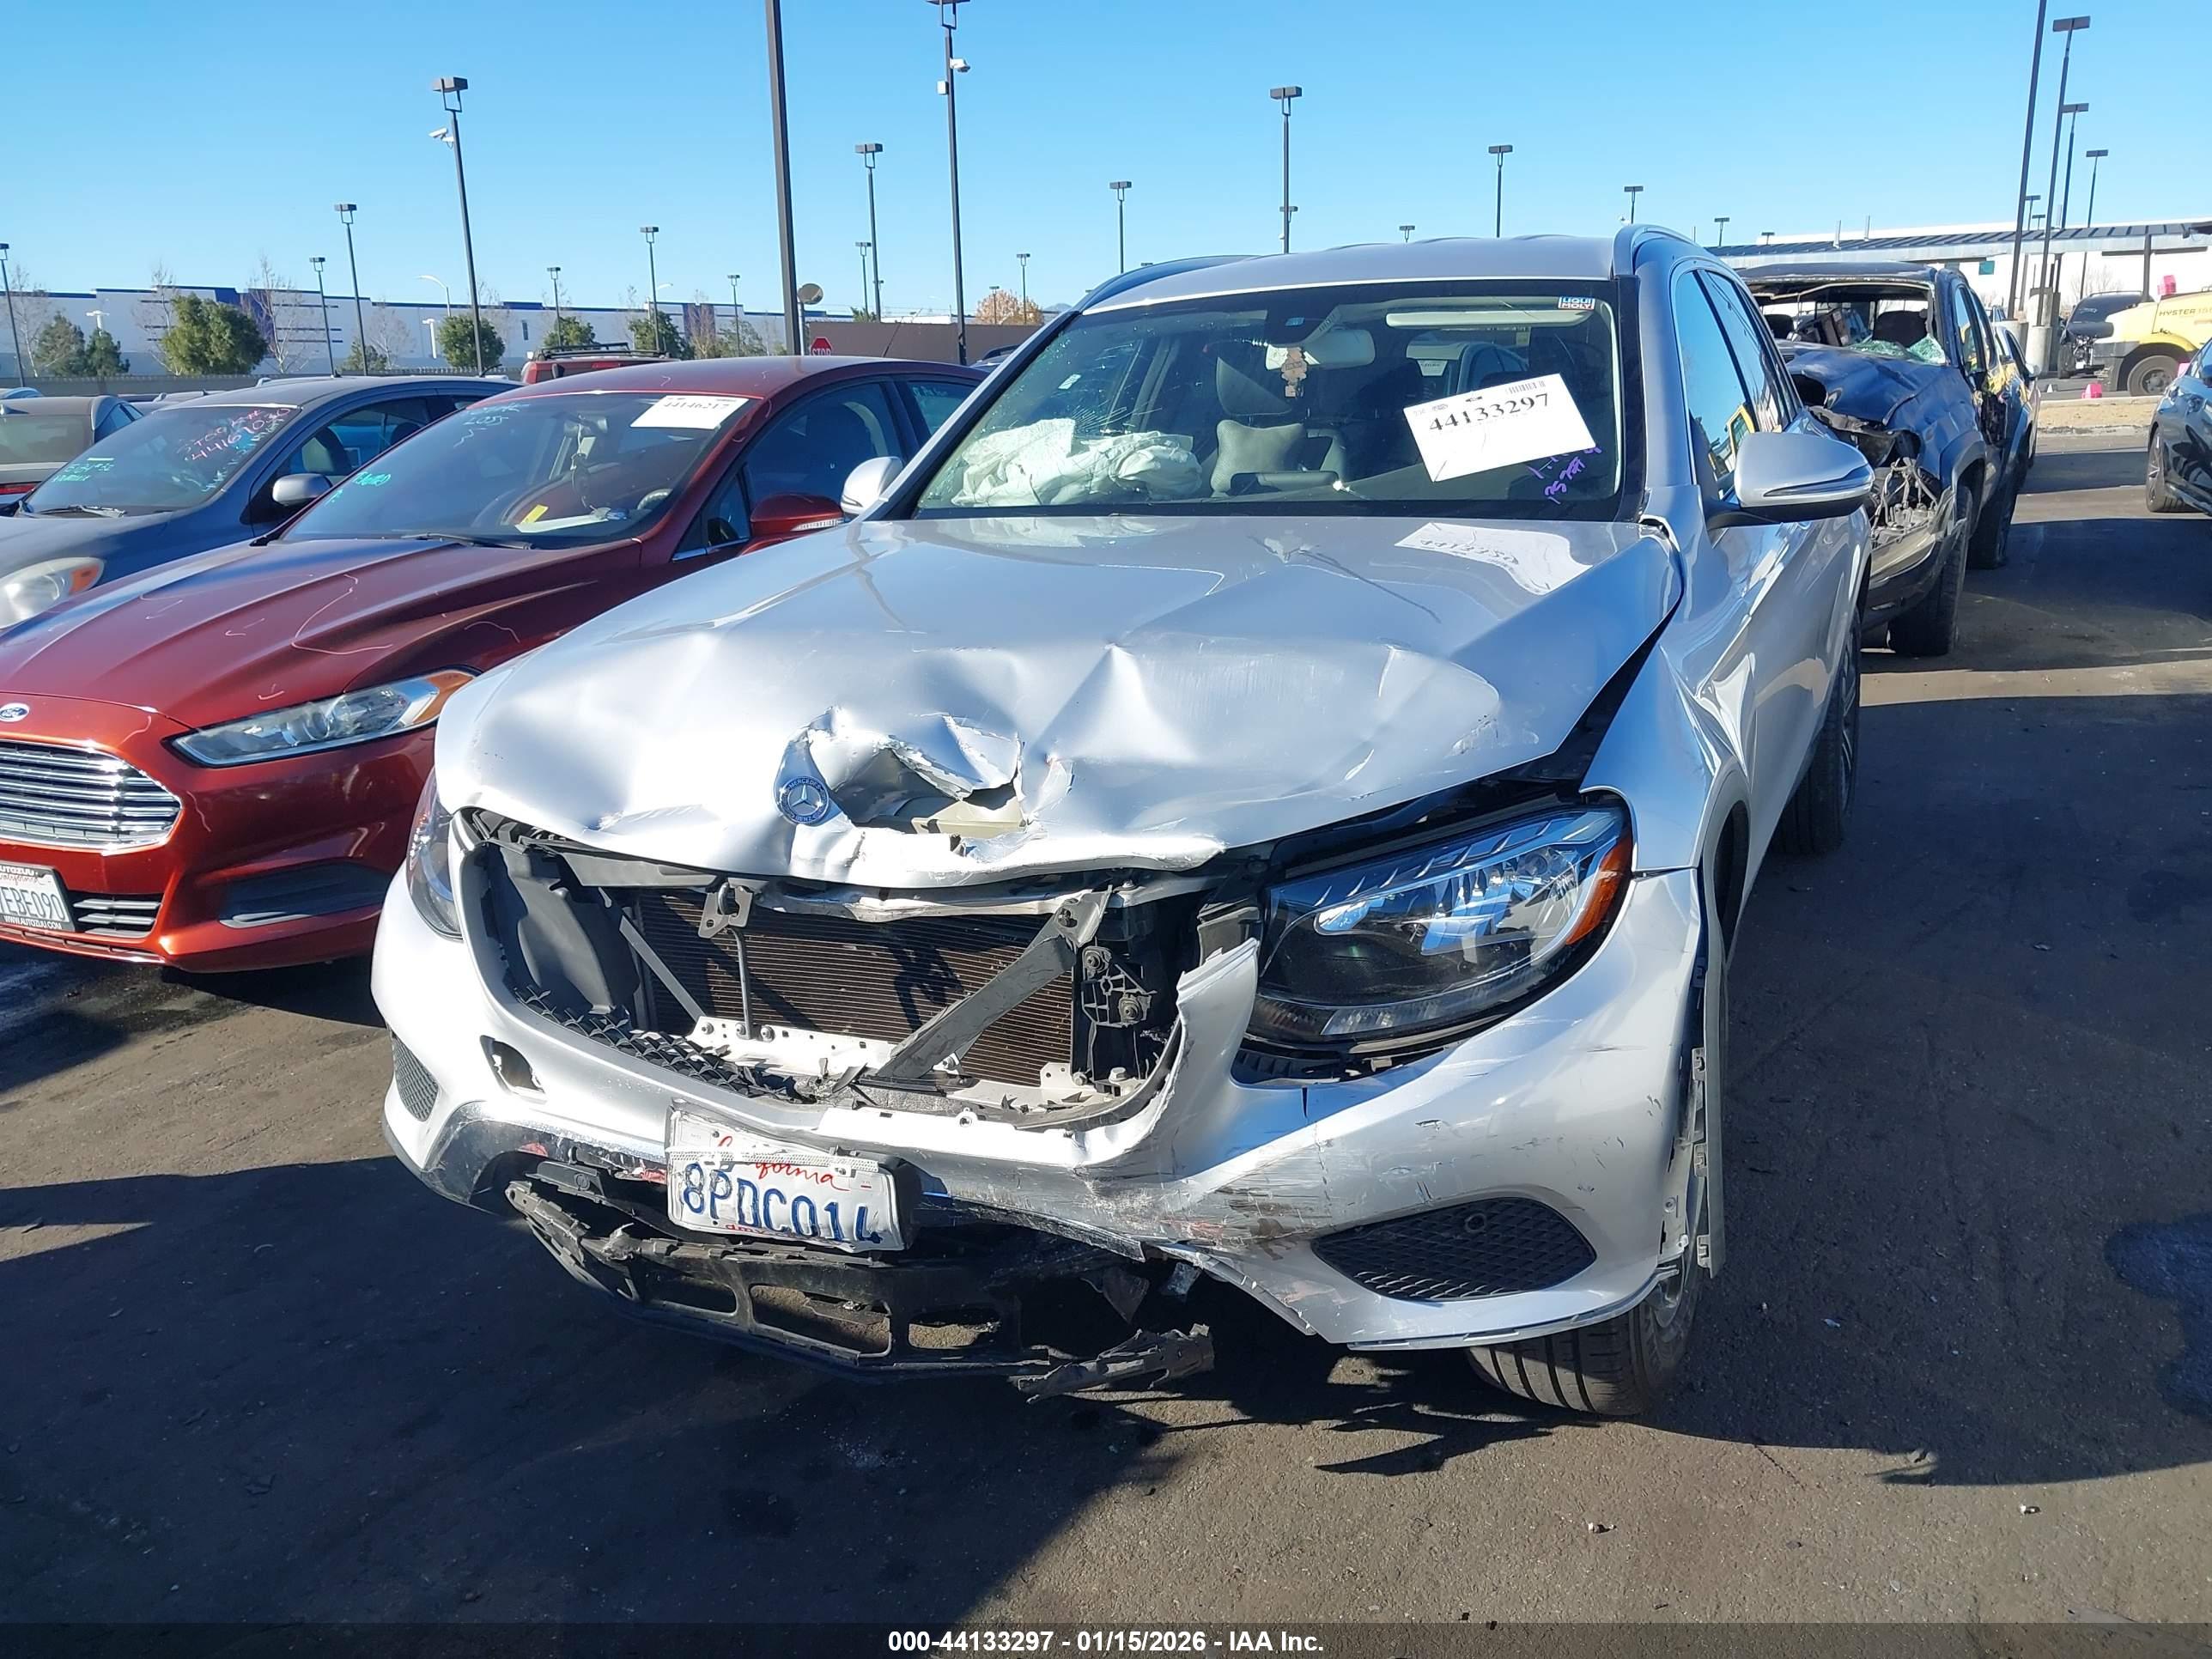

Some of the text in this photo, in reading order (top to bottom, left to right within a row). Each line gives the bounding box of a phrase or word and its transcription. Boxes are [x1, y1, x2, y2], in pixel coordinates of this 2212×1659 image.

[1429, 392, 1549, 431] 44133297
[788, 777, 822, 790] MERCEDES
[0, 864, 35, 876] UTOZUU
